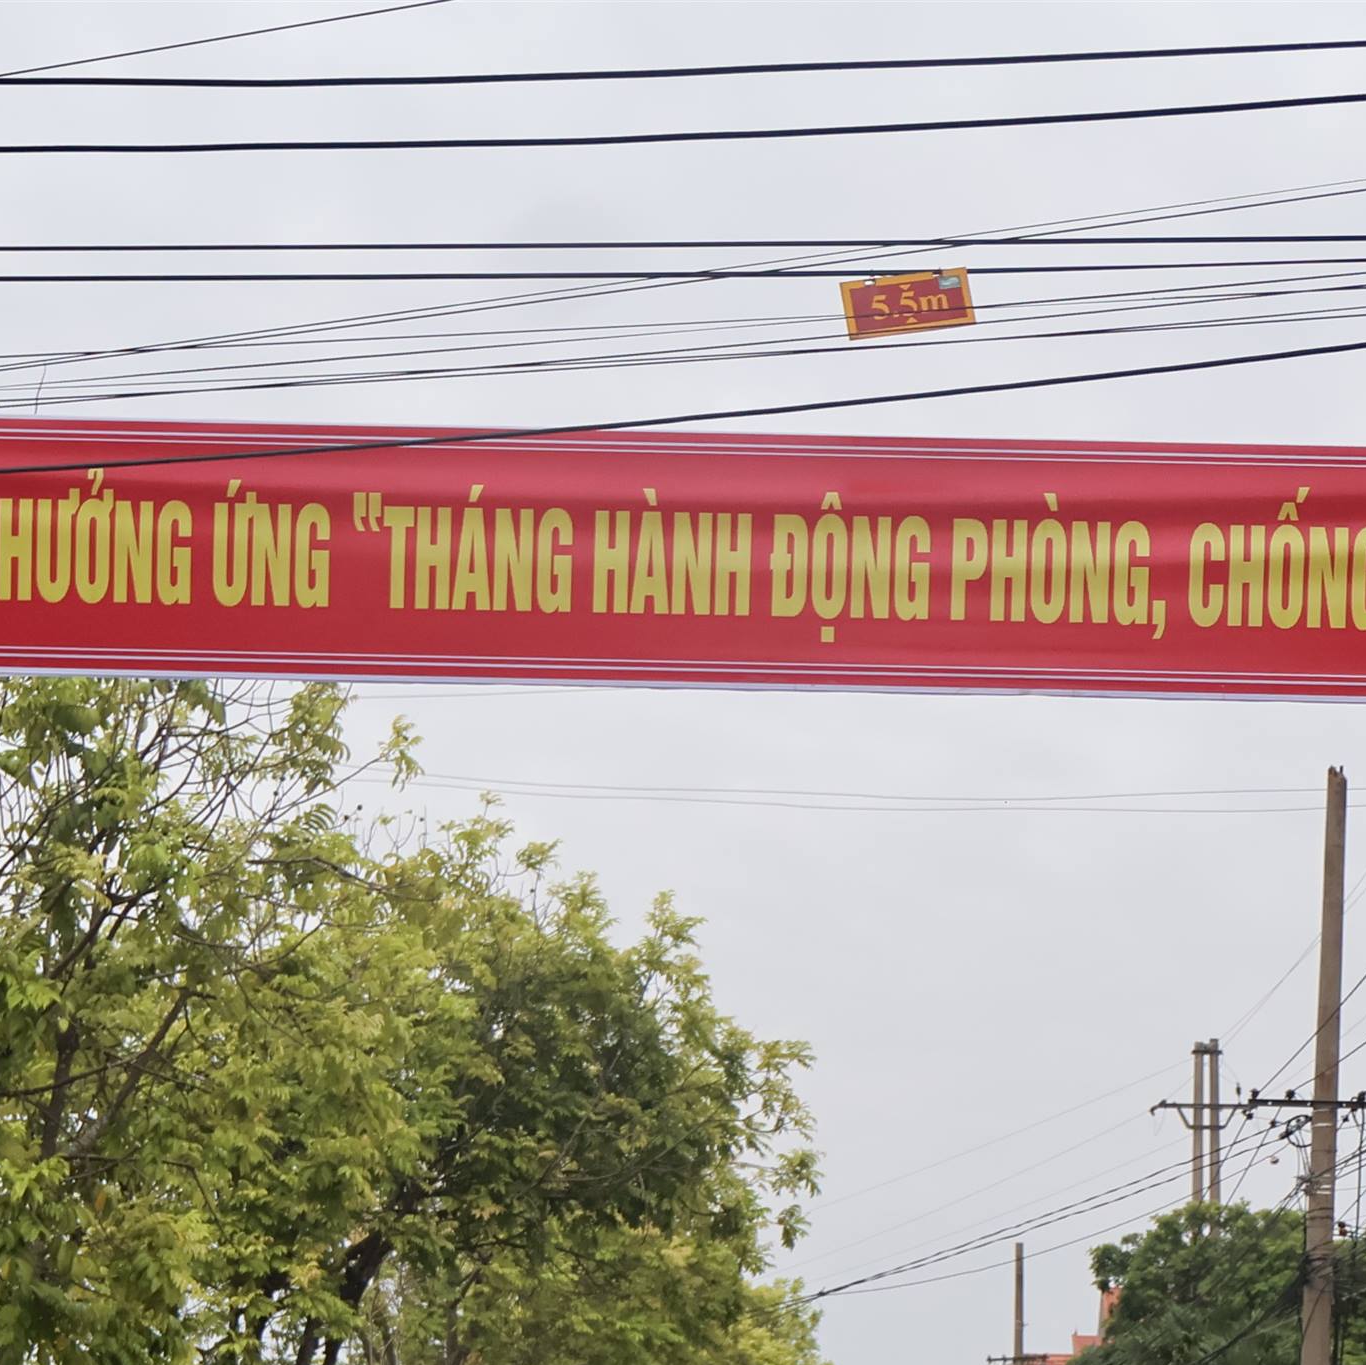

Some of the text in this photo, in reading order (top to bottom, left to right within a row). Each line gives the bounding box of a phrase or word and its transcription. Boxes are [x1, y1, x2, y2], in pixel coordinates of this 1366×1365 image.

[870, 290, 950, 320] 5.5m
[214, 479, 330, 607] ỨNG
[594, 486, 752, 615] HÀNH
[770, 492, 931, 642] ĐỘNG
[951, 493, 1167, 638] PHÒNG,
